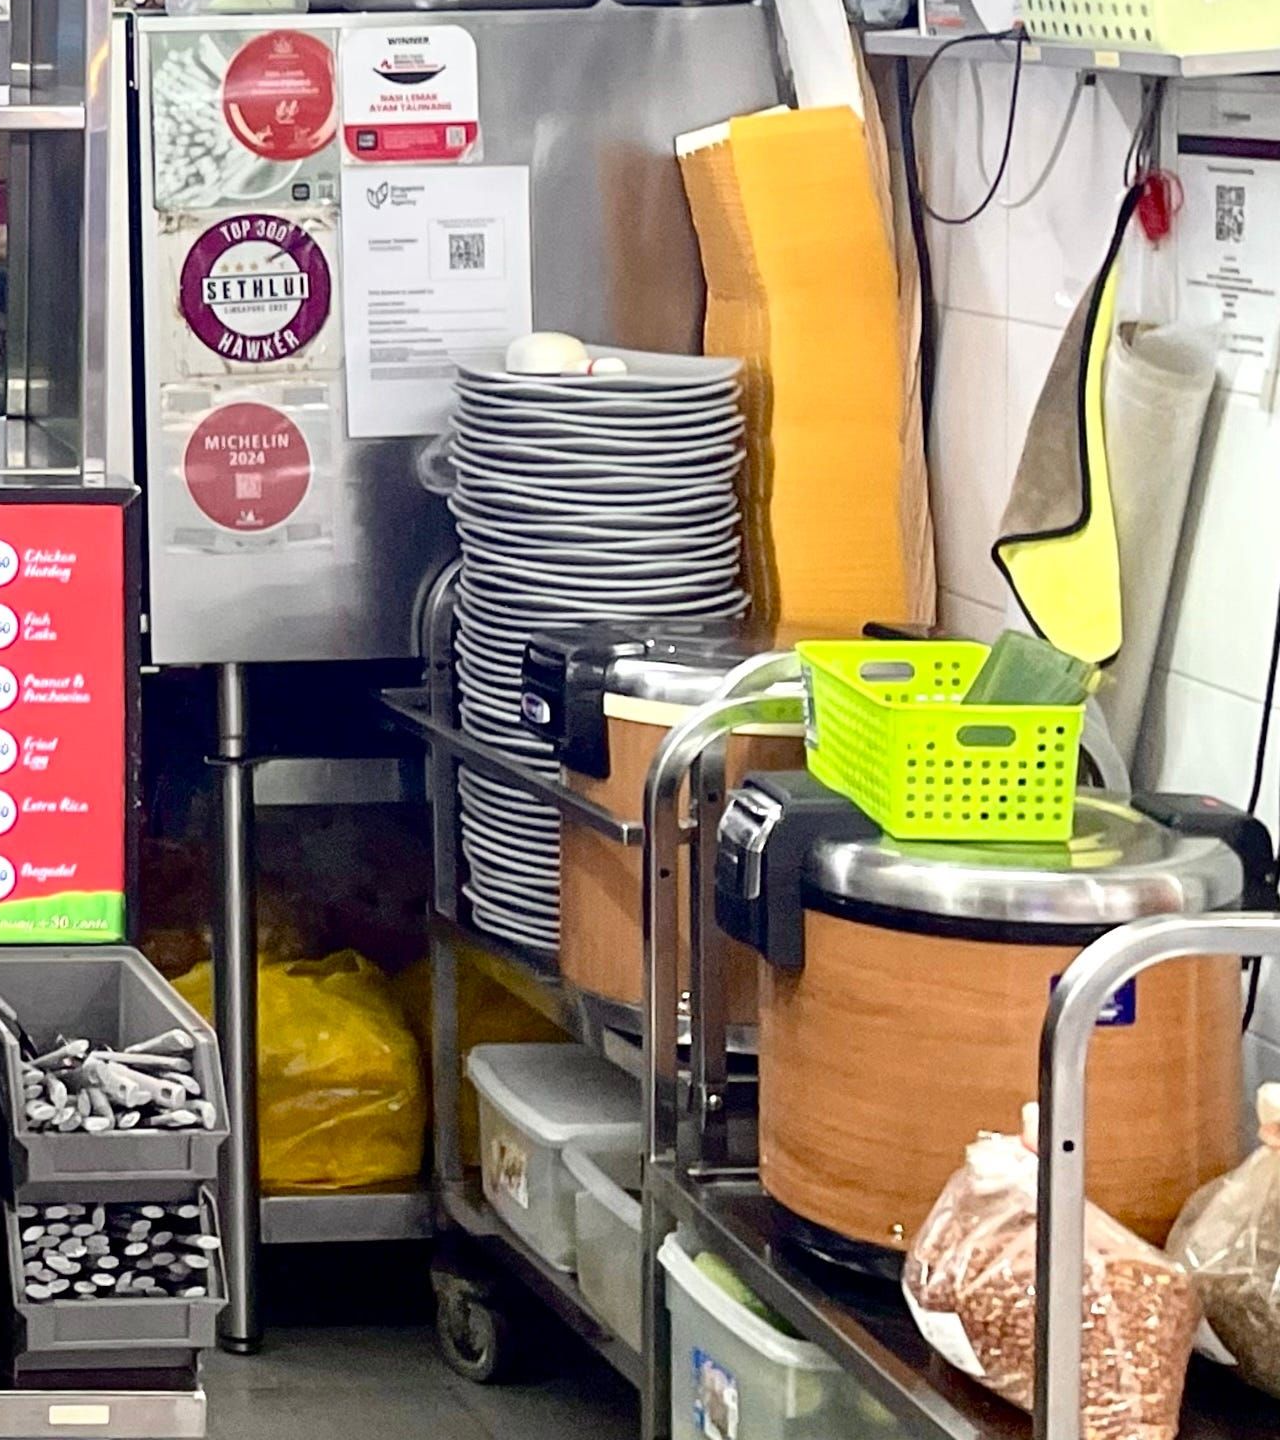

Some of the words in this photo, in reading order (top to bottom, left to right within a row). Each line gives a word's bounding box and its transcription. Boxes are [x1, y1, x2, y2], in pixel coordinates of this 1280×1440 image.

[386, 36, 429, 46] WINNER
[220, 221, 251, 244] TOP
[255, 219, 288, 242] 300
[206, 276, 307, 302] SETHLUI
[217, 328, 302, 362] HAWKER
[204, 433, 290, 451] MICHELIN
[229, 452, 266, 467] 2024
[23, 547, 78, 564] Chicken
[22, 752, 50, 771] Egg
[59, 796, 89, 813] Rice
[51, 915, 70, 929] 30
